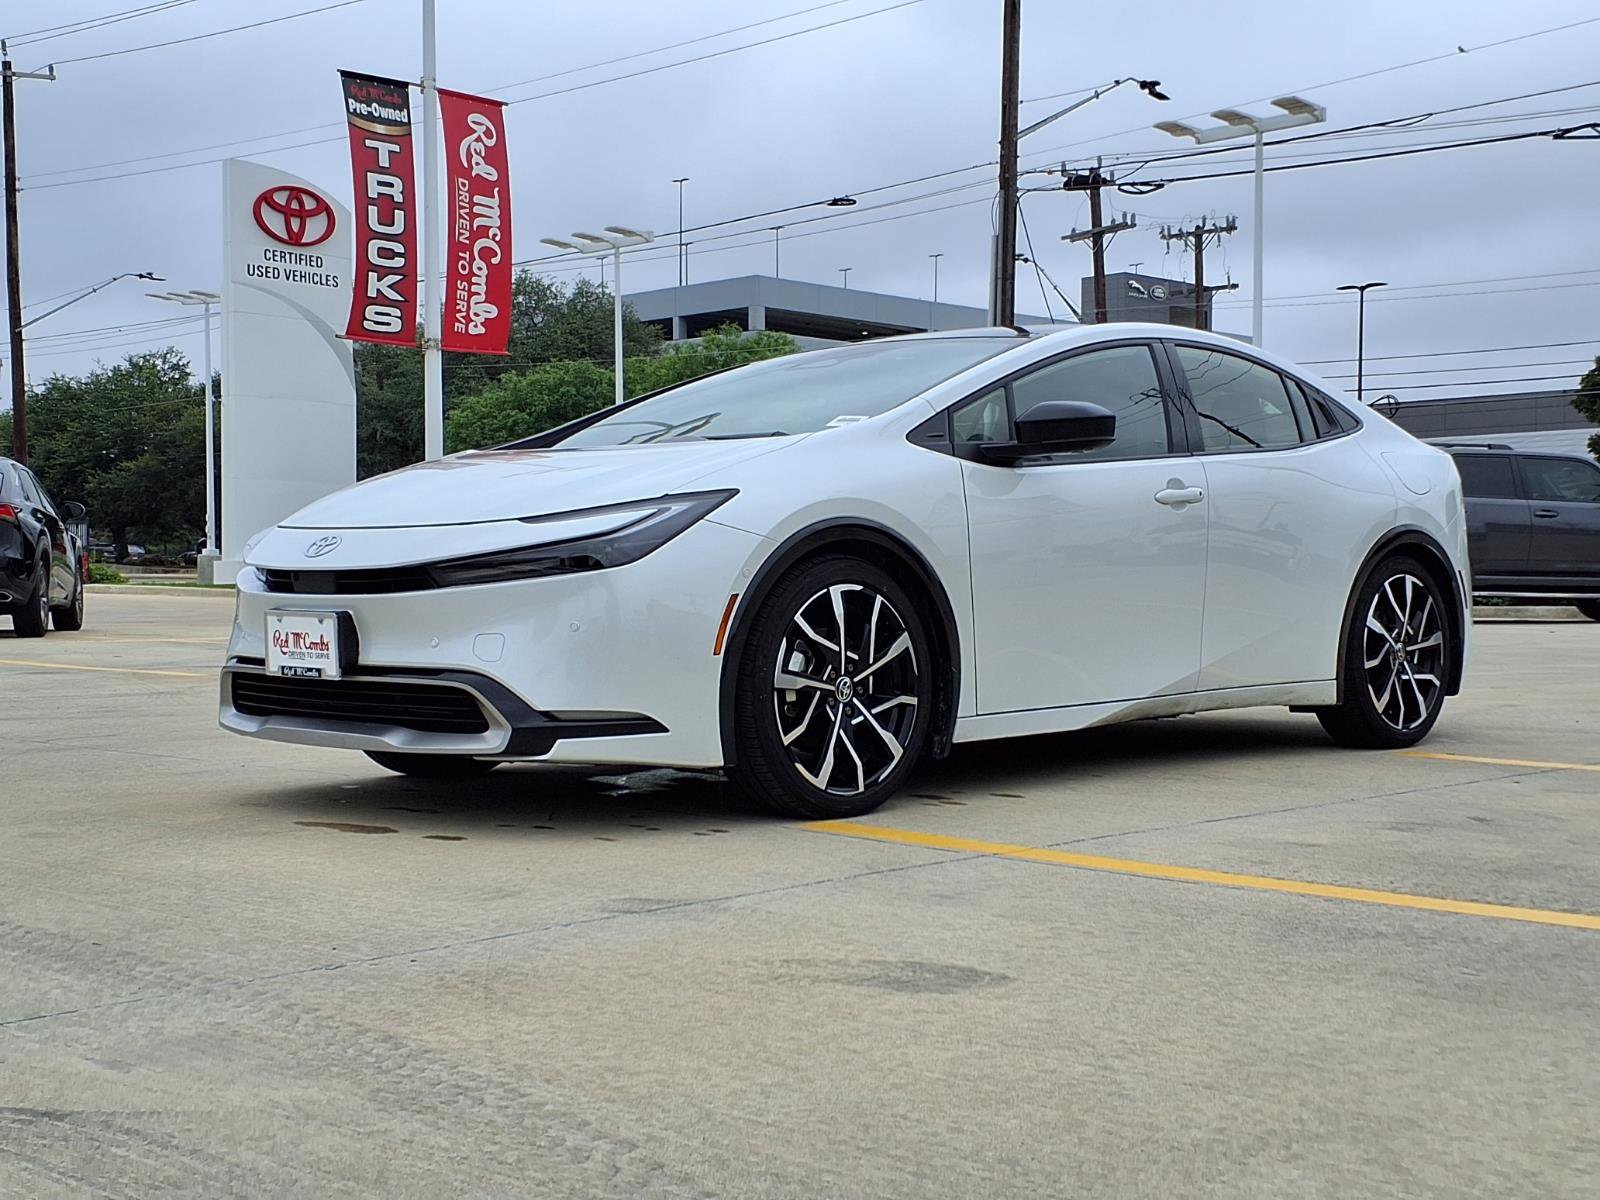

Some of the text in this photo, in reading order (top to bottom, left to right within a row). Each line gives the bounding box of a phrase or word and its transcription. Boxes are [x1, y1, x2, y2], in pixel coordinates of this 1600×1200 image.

[348, 98, 409, 123] Pre-Owned
[363, 138, 407, 333] TRUCKS
[460, 113, 502, 335] Red McCombs
[263, 248, 324, 269] CERTIFIED
[454, 177, 470, 334] DRIVEN TO SERVE
[246, 263, 340, 288] USED VEHICLES
[273, 629, 330, 655] Red McCombs
[288, 650, 306, 659] DRIVEN
[315, 652, 330, 660] SERVE
